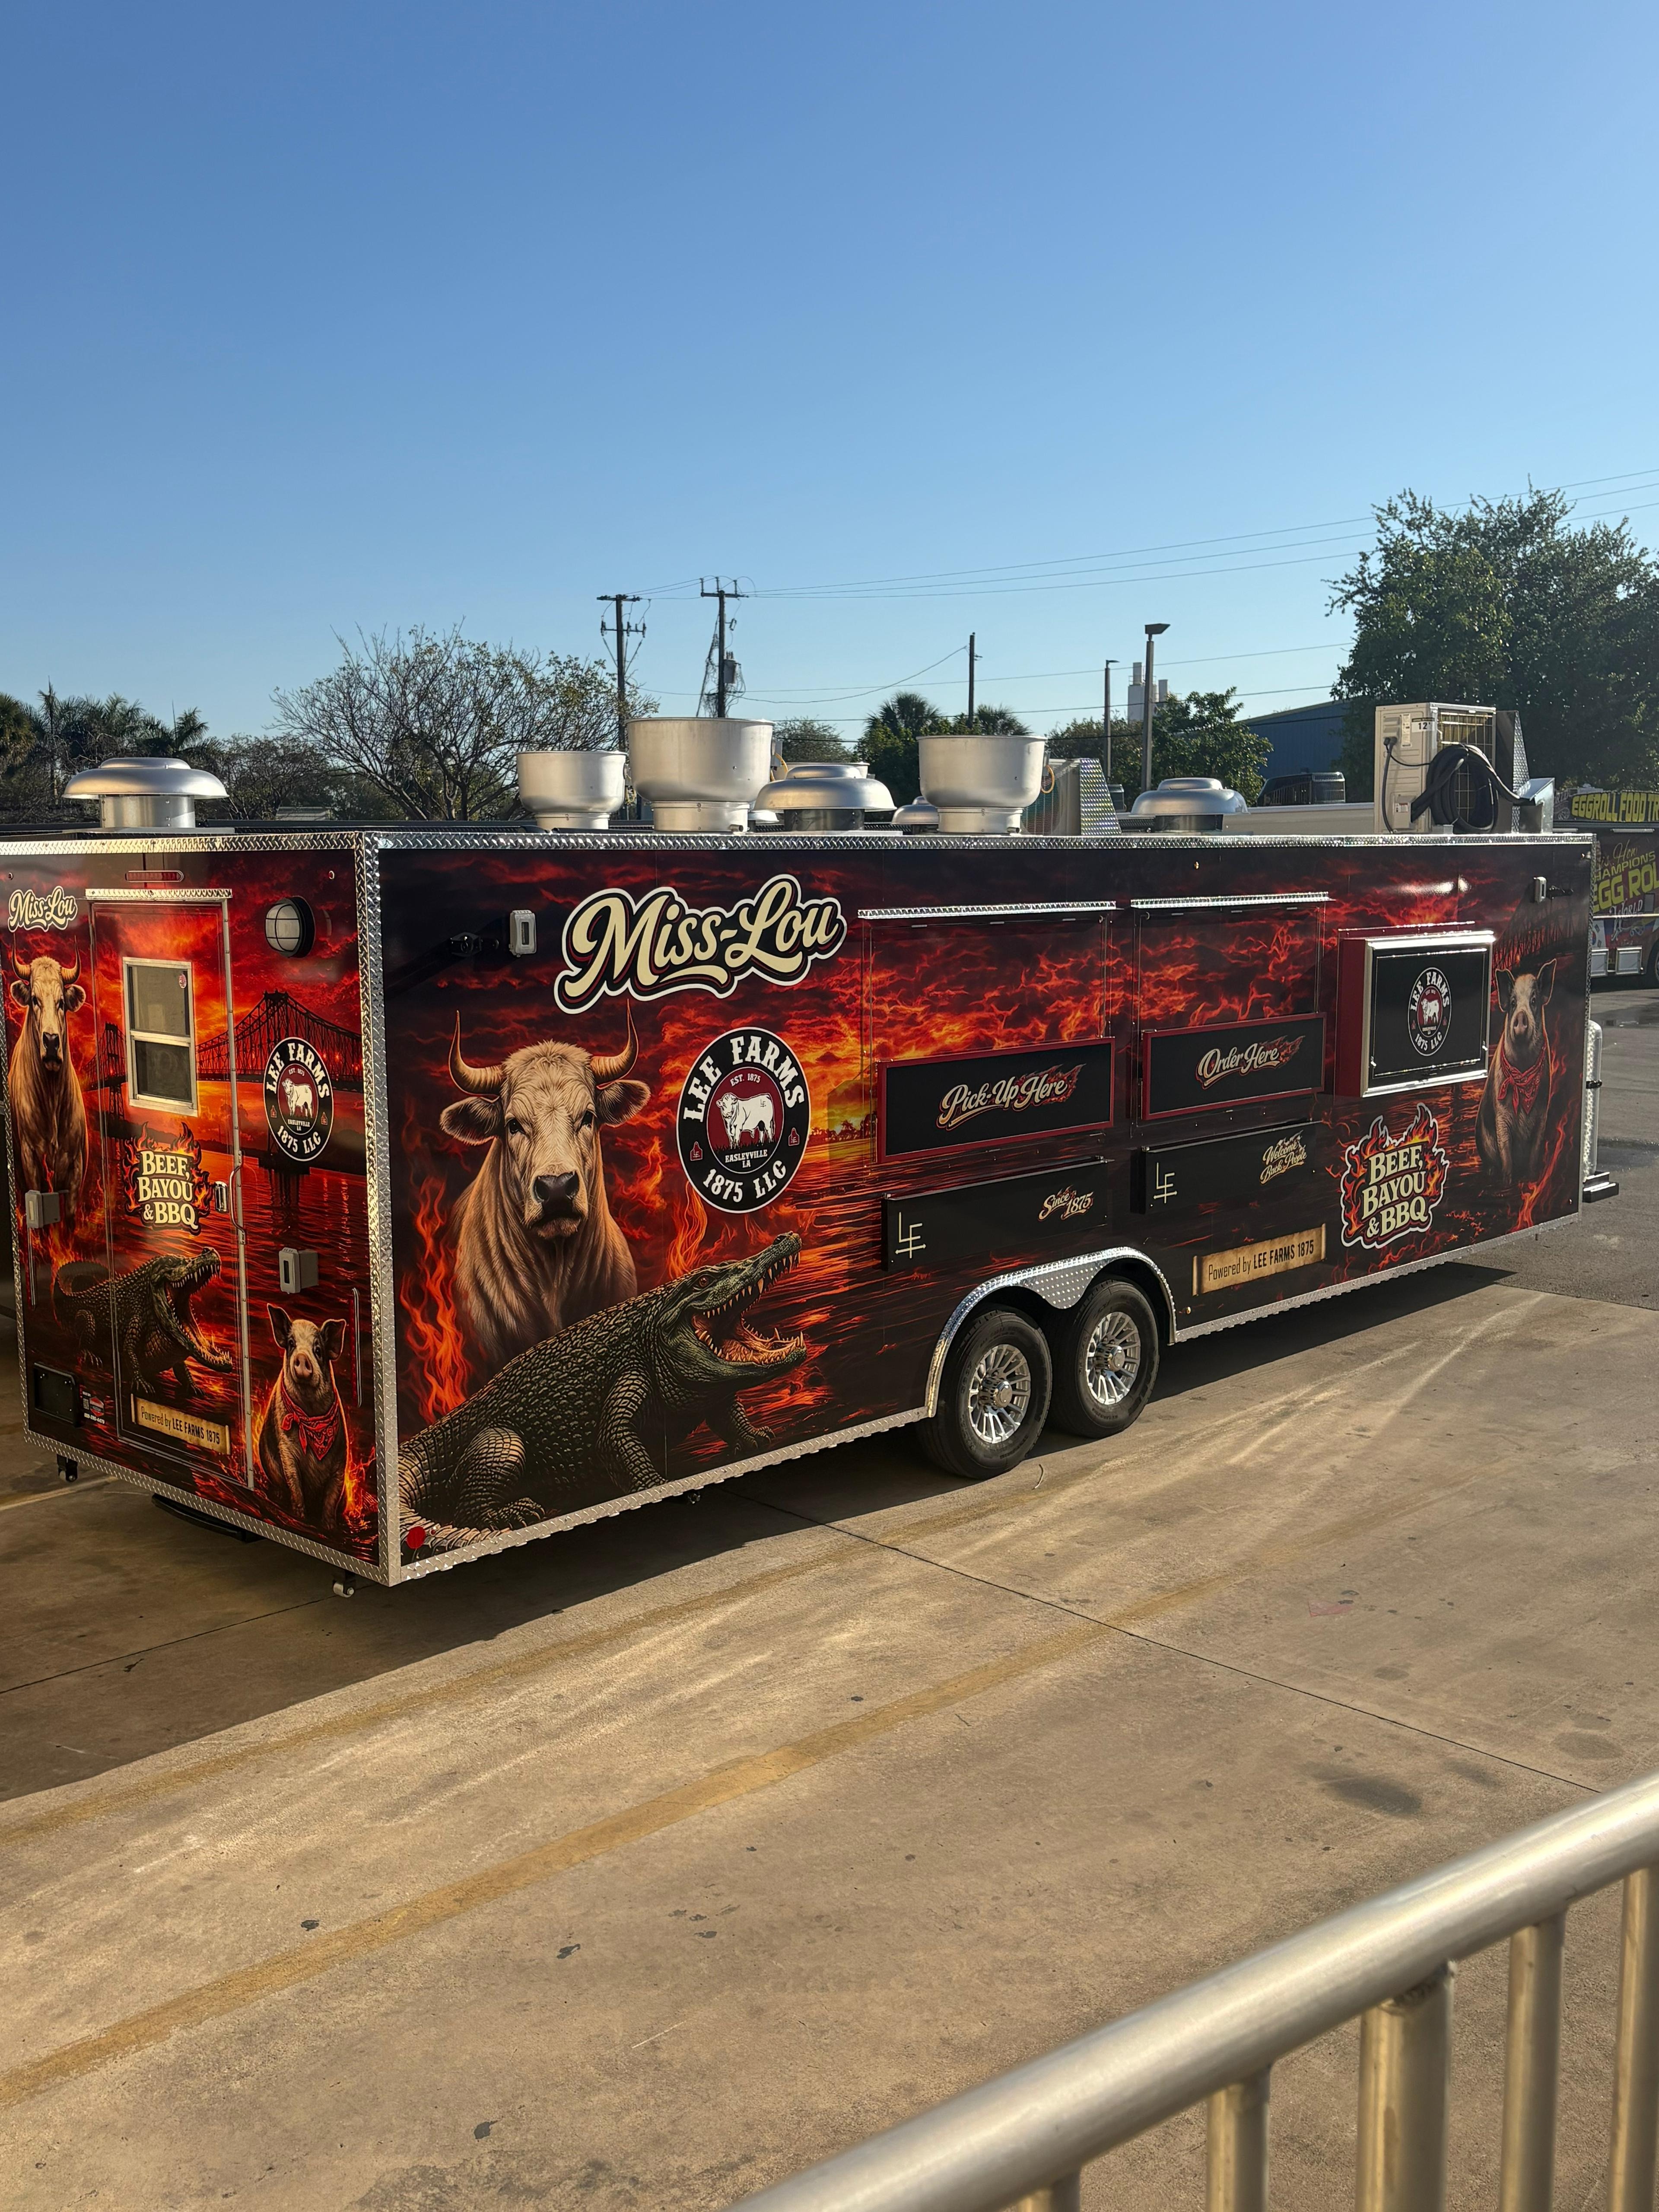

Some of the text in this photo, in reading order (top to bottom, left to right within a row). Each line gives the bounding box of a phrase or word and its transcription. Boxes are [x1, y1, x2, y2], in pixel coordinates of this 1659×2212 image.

[1619, 791, 1647, 822] FOOD
[1594, 850, 1656, 883] HAMPIONS
[10, 887, 76, 928] Miss-Lou
[562, 878, 841, 999] Miss-Lou
[1410, 971, 1449, 1012] LEE FARMS
[1414, 1031, 1443, 1051] 1875 LLC
[266, 1042, 330, 1098] LEE FARMS
[1198, 1043, 1279, 1079] Order Here
[683, 1035, 805, 1123] LEE FARMS
[730, 1073, 761, 1087] EST. 1875
[939, 1074, 1068, 1125] Pick-Up Here
[277, 1125, 321, 1154] 1875 LLC
[725, 1149, 768, 1163] EASLEYVILLE
[1262, 1141, 1298, 1165] Welcome
[140, 1150, 191, 1181] BEEF,
[702, 1160, 787, 1203] 1875 LLC
[1260, 1160, 1284, 1184] Back
[1369, 1145, 1423, 1185] BEEF,
[137, 1176, 194, 1202] BAYOU
[1062, 1192, 1093, 1218] 1875
[1361, 1171, 1427, 1220] BAYOU
[1039, 1193, 1070, 1220] Since
[1208, 1239, 1314, 1281] Powered by LEE FARMS 1875
[141, 1406, 220, 1445] Powered by LEE FARMS 1875
